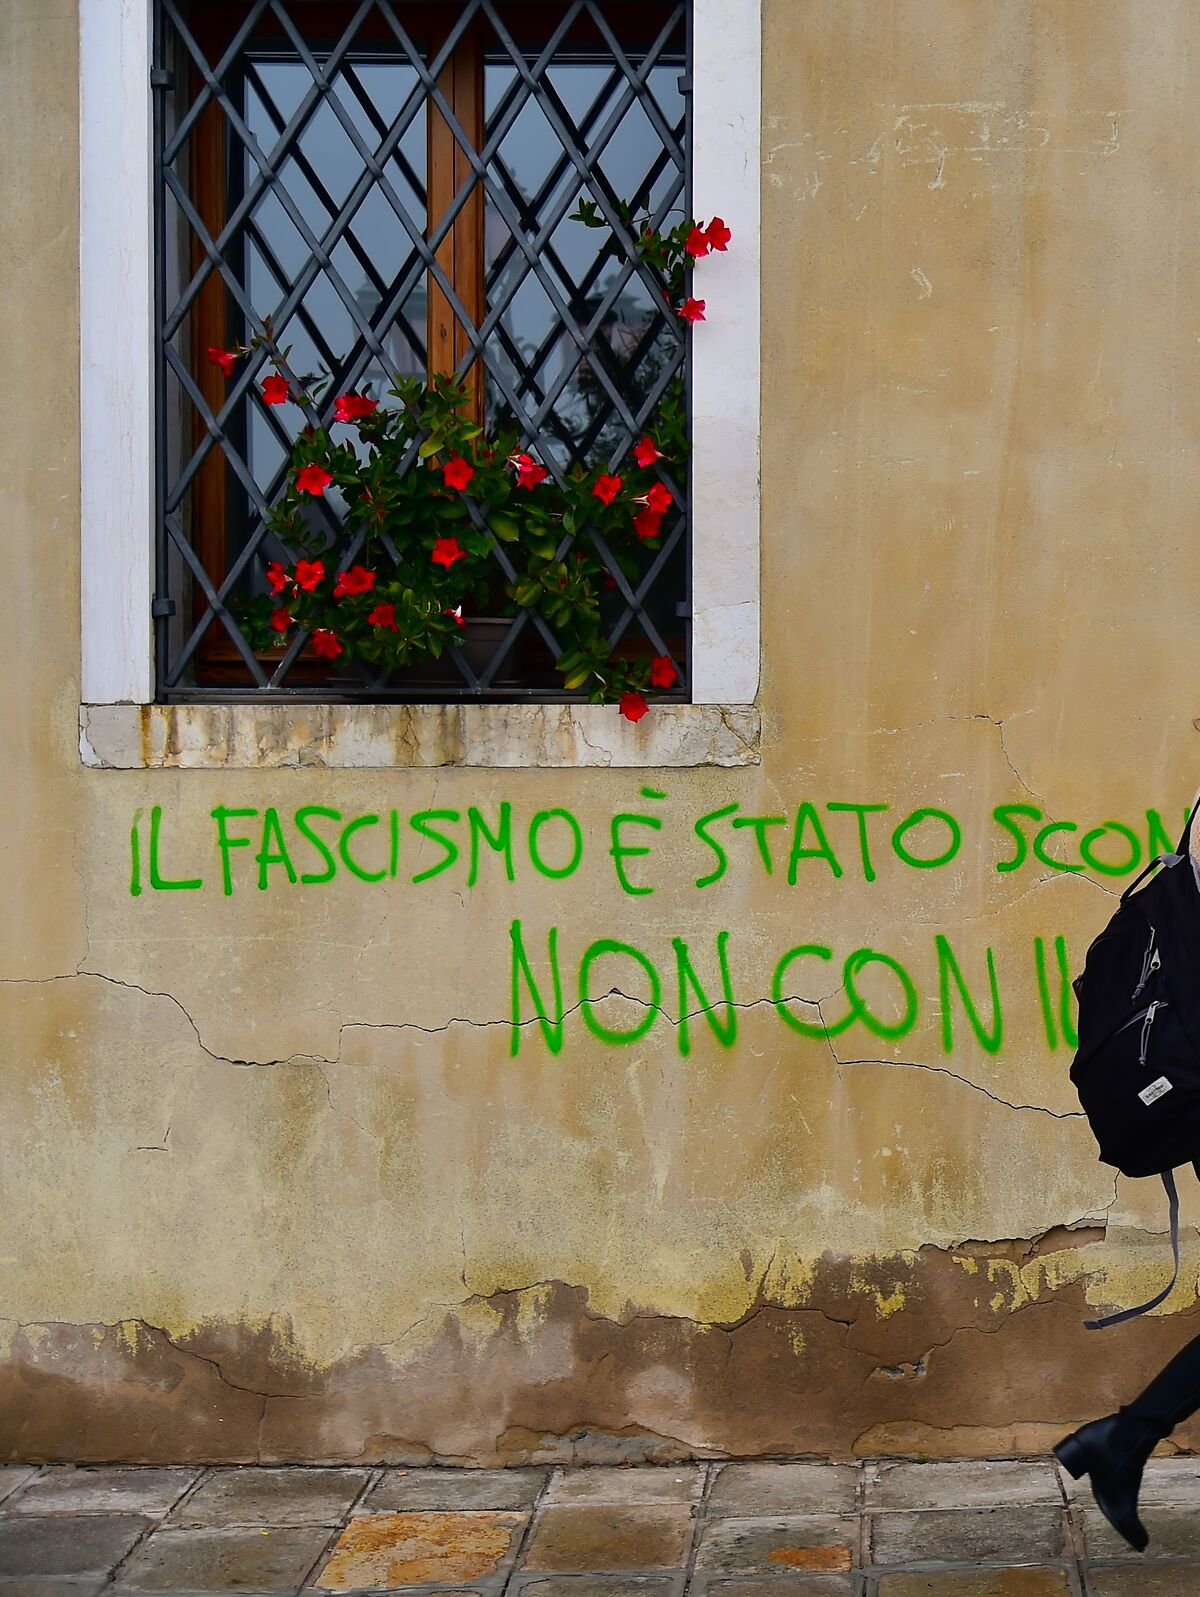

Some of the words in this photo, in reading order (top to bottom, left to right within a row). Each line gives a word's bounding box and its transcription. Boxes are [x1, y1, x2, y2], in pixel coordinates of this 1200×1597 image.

[128, 804, 205, 897] IL
[209, 800, 584, 898] FASCISMO
[608, 785, 668, 897] È
[693, 800, 963, 888] STATO
[508, 917, 739, 1060] NON
[770, 932, 1005, 1057] CON
